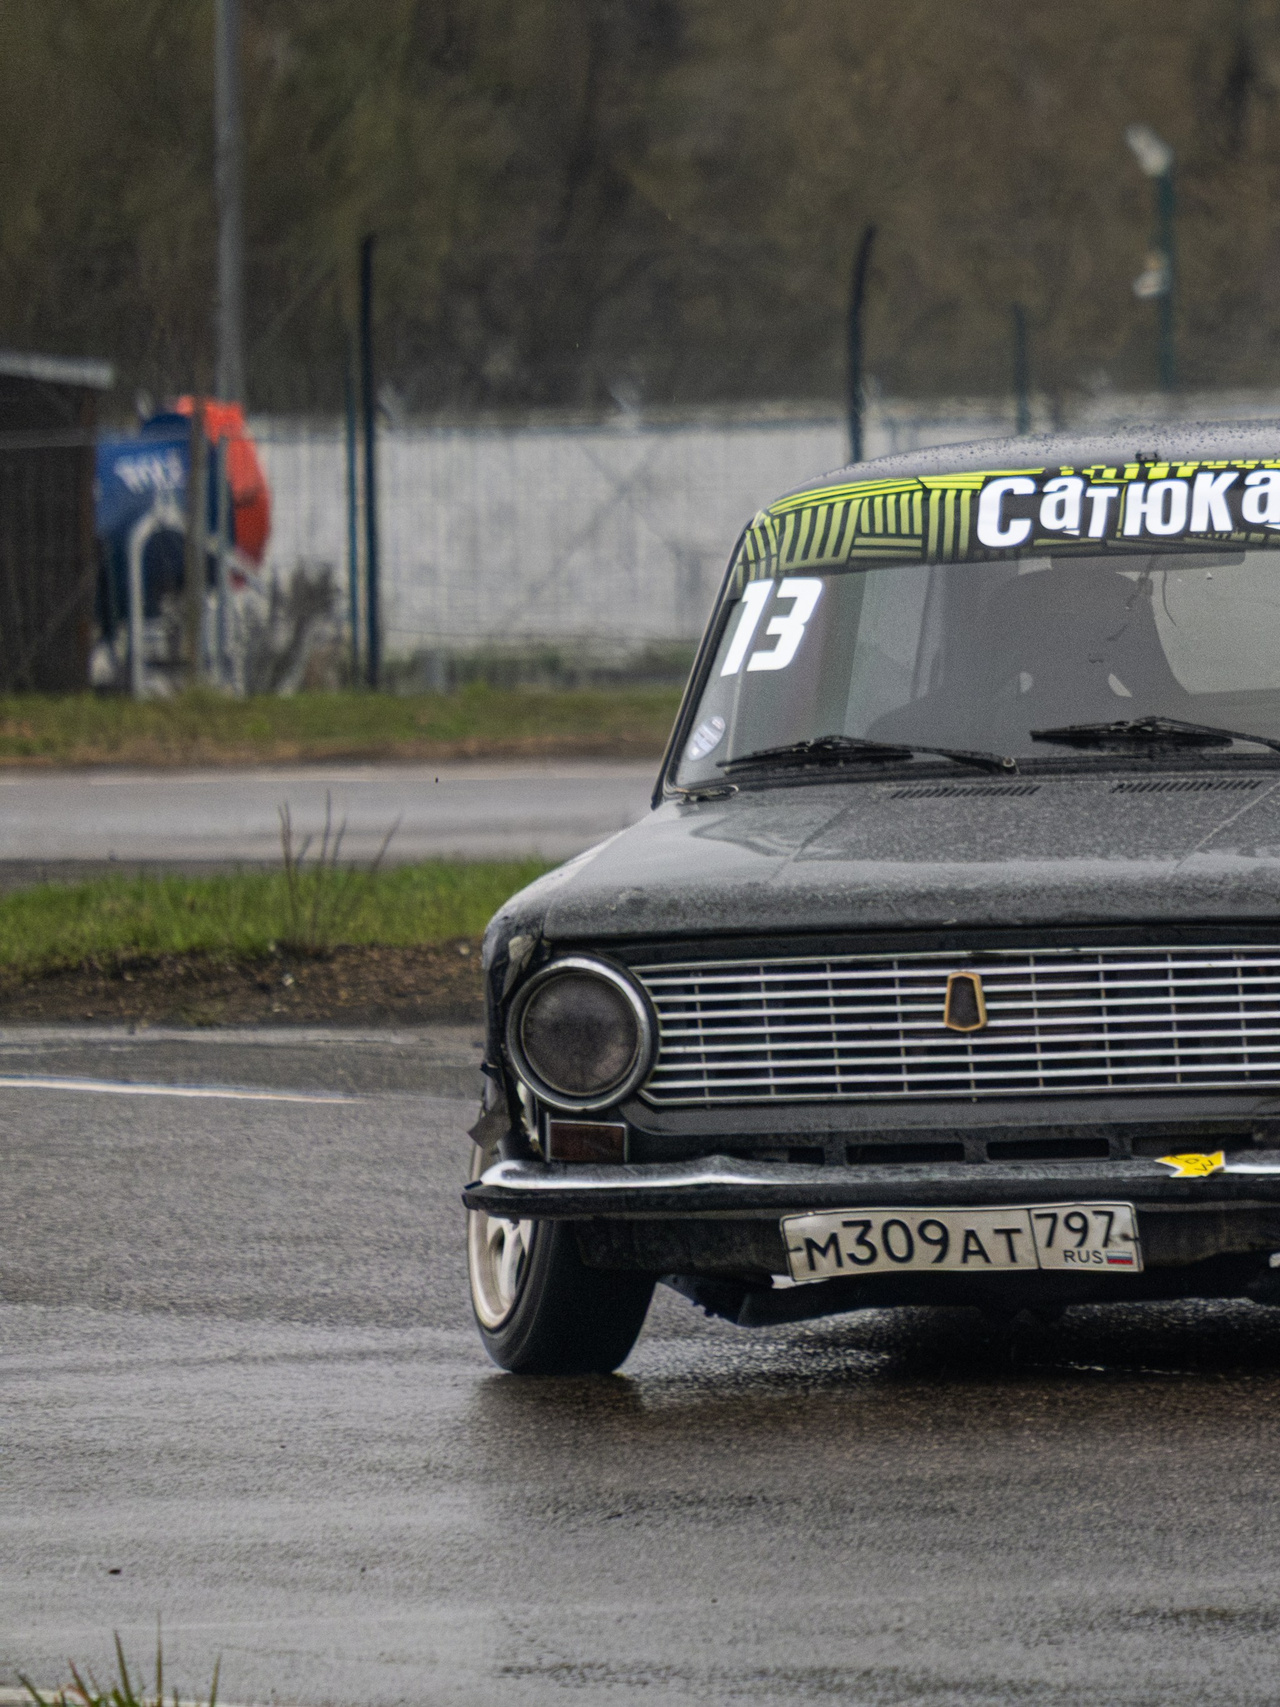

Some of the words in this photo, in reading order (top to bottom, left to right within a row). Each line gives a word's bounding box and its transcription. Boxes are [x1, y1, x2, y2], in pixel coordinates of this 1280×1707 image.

[720, 576, 823, 677] 13
[1034, 1210, 1115, 1249] 797
[1063, 1249, 1103, 1264] RUS
